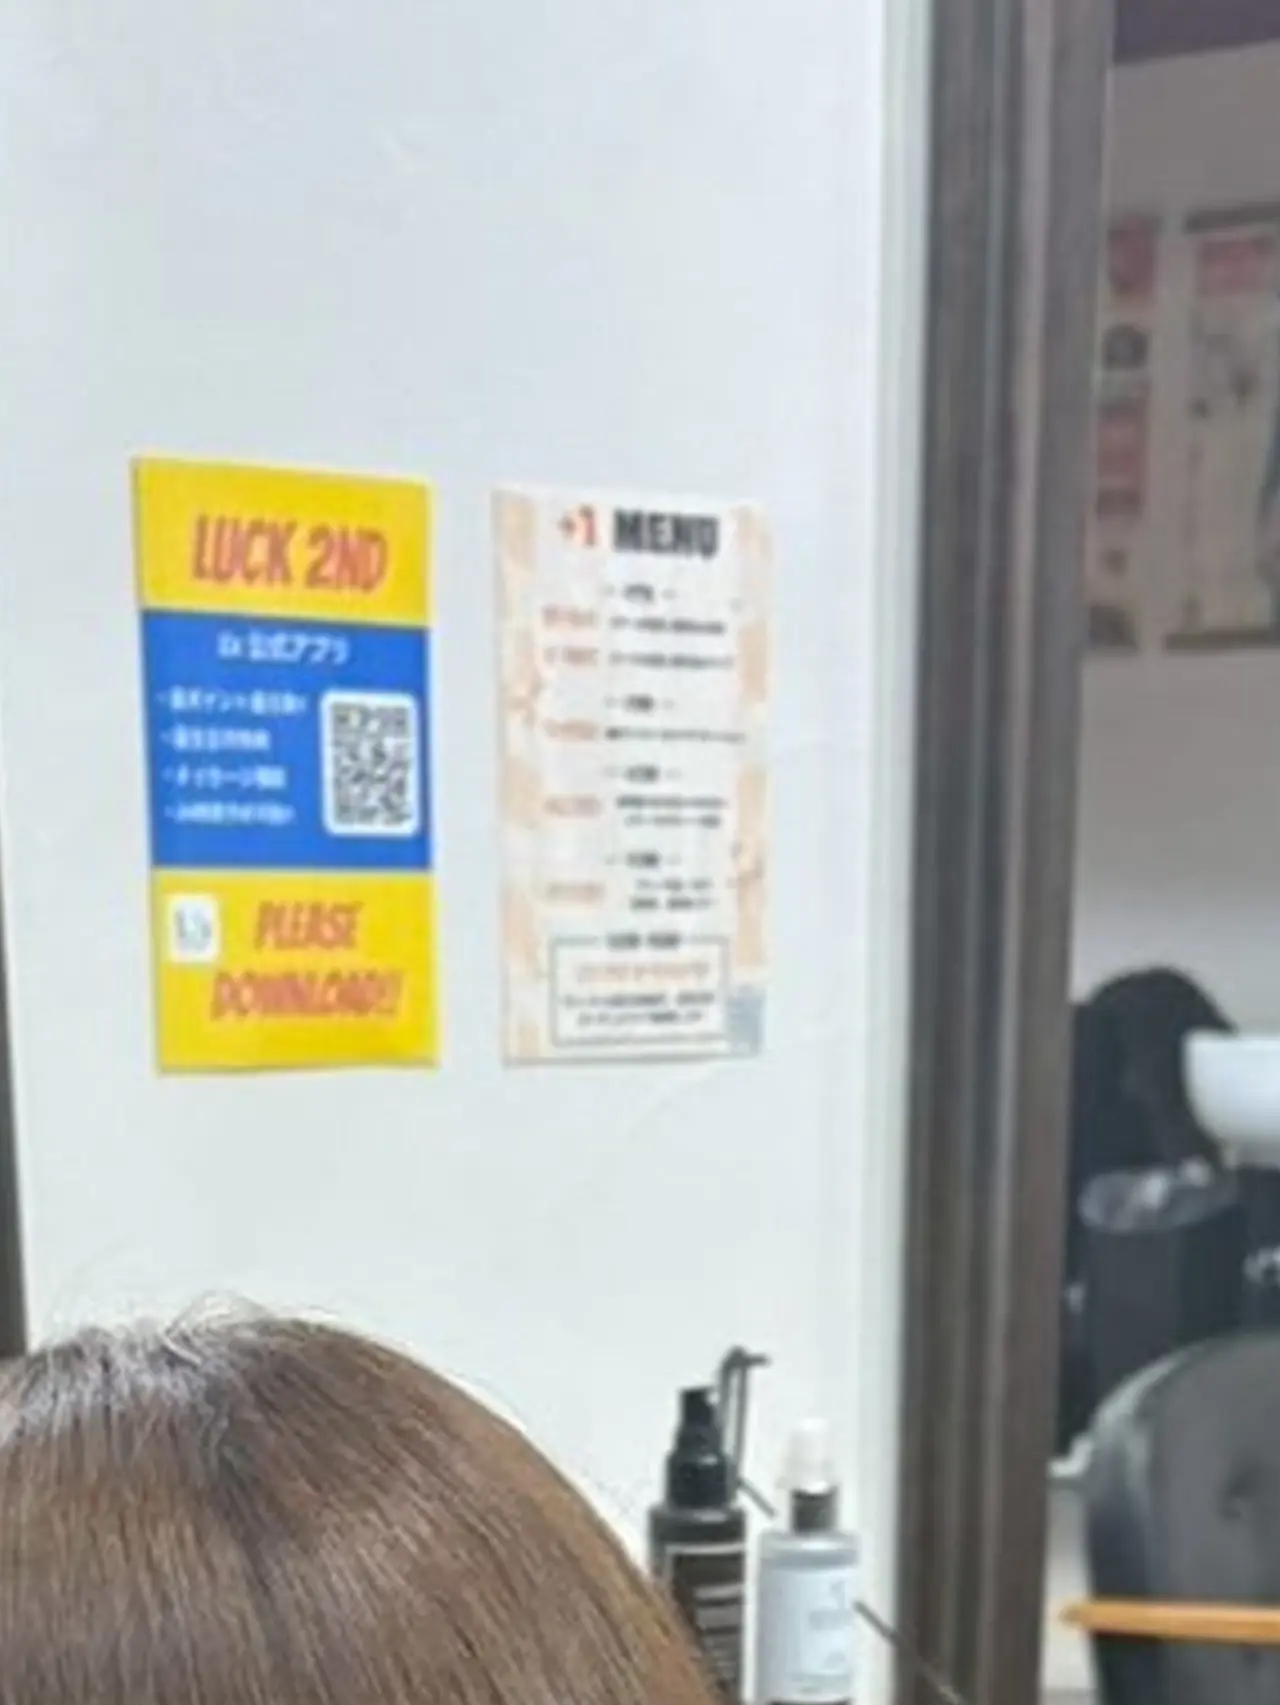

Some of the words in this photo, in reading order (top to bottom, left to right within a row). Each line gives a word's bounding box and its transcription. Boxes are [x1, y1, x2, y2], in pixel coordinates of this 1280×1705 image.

[193, 512, 298, 587] LUCK
[305, 522, 389, 594] 2ND
[612, 508, 719, 560] MENU
[254, 900, 364, 952] PLEASE
